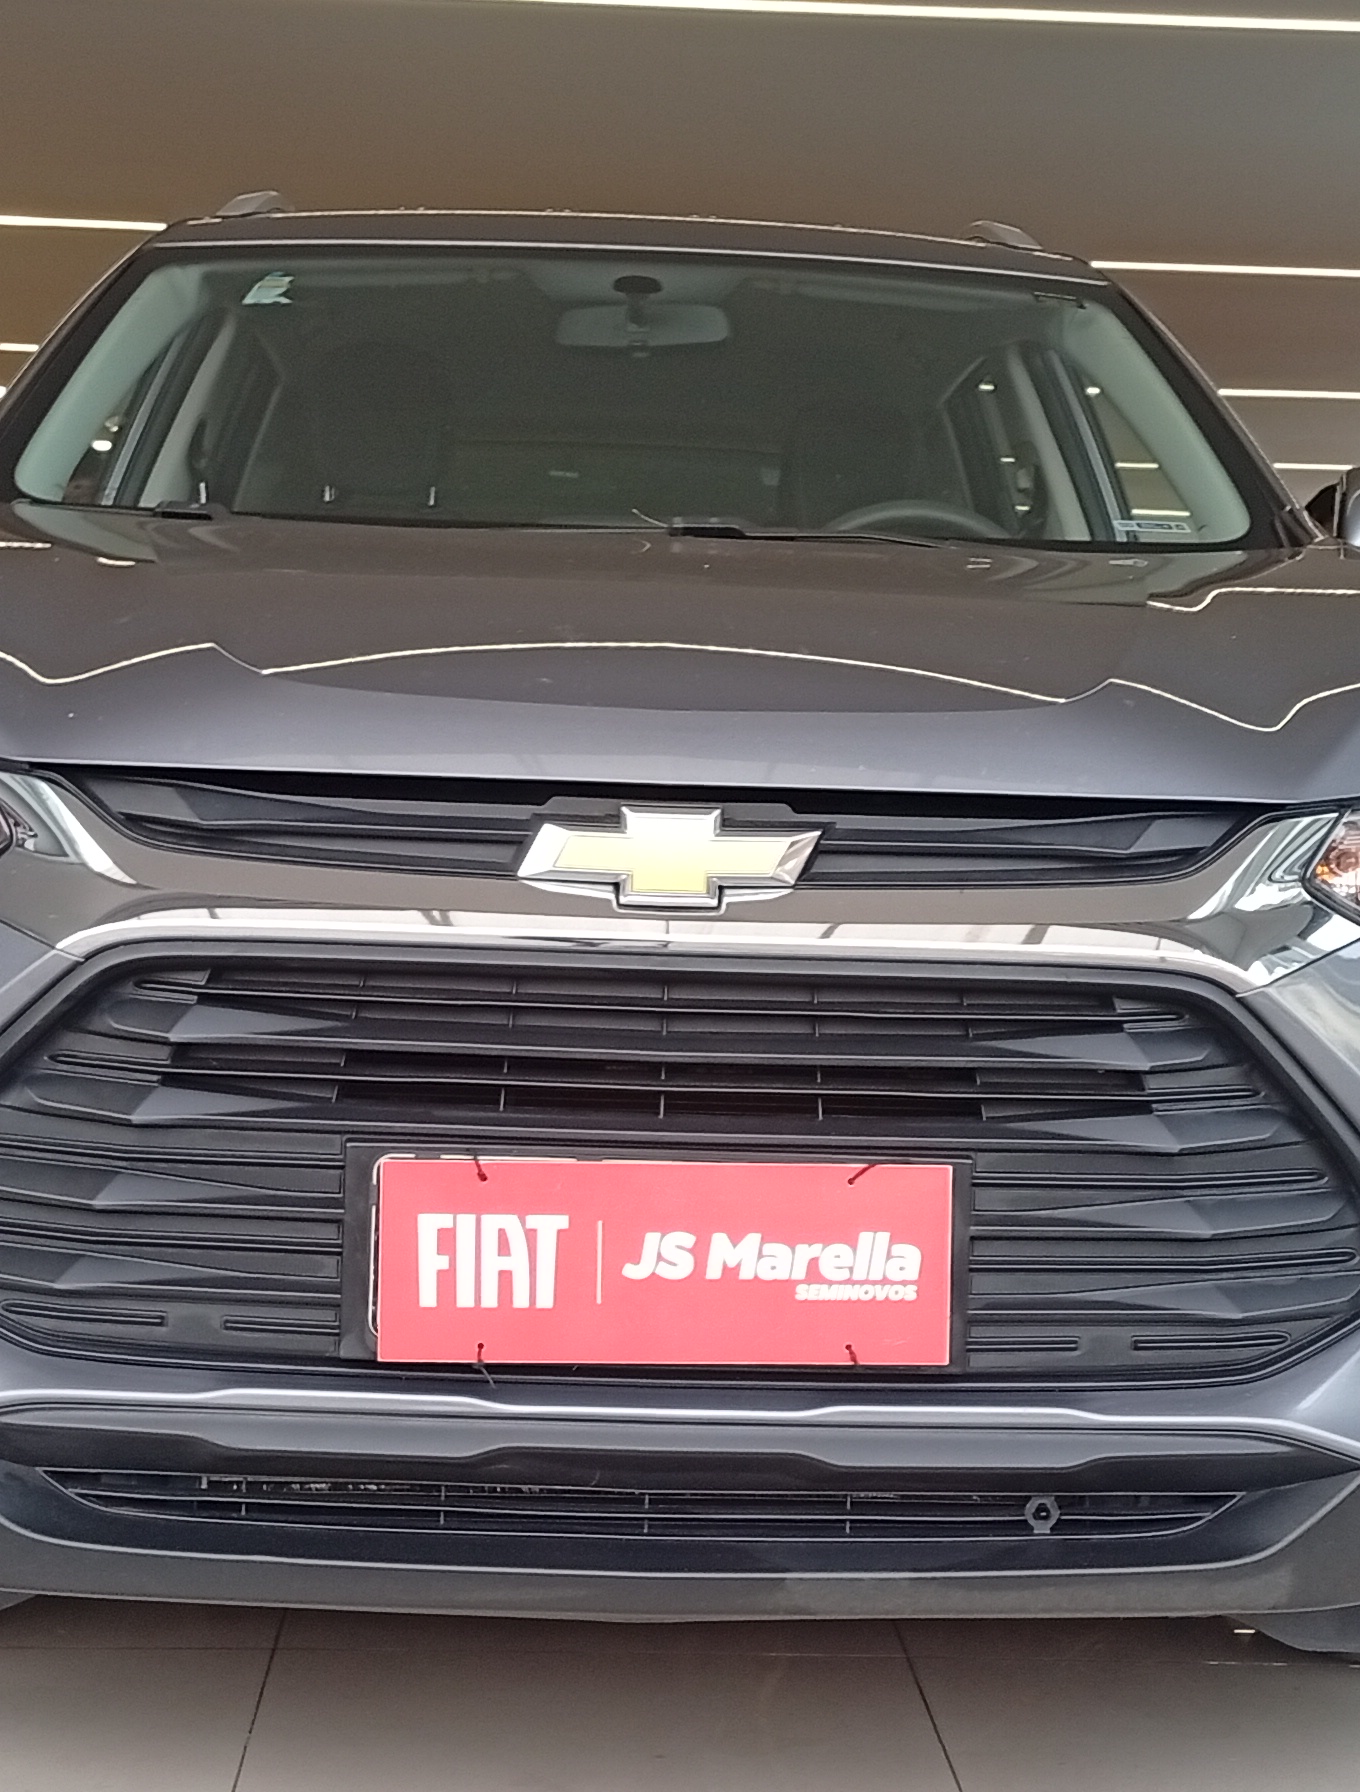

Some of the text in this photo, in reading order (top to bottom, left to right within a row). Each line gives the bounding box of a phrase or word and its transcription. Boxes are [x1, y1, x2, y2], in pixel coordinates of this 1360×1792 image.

[416, 1212, 570, 1309] FIAT
[621, 1230, 922, 1282] JS Marella
[794, 1283, 919, 1302] SEMINOVOS
